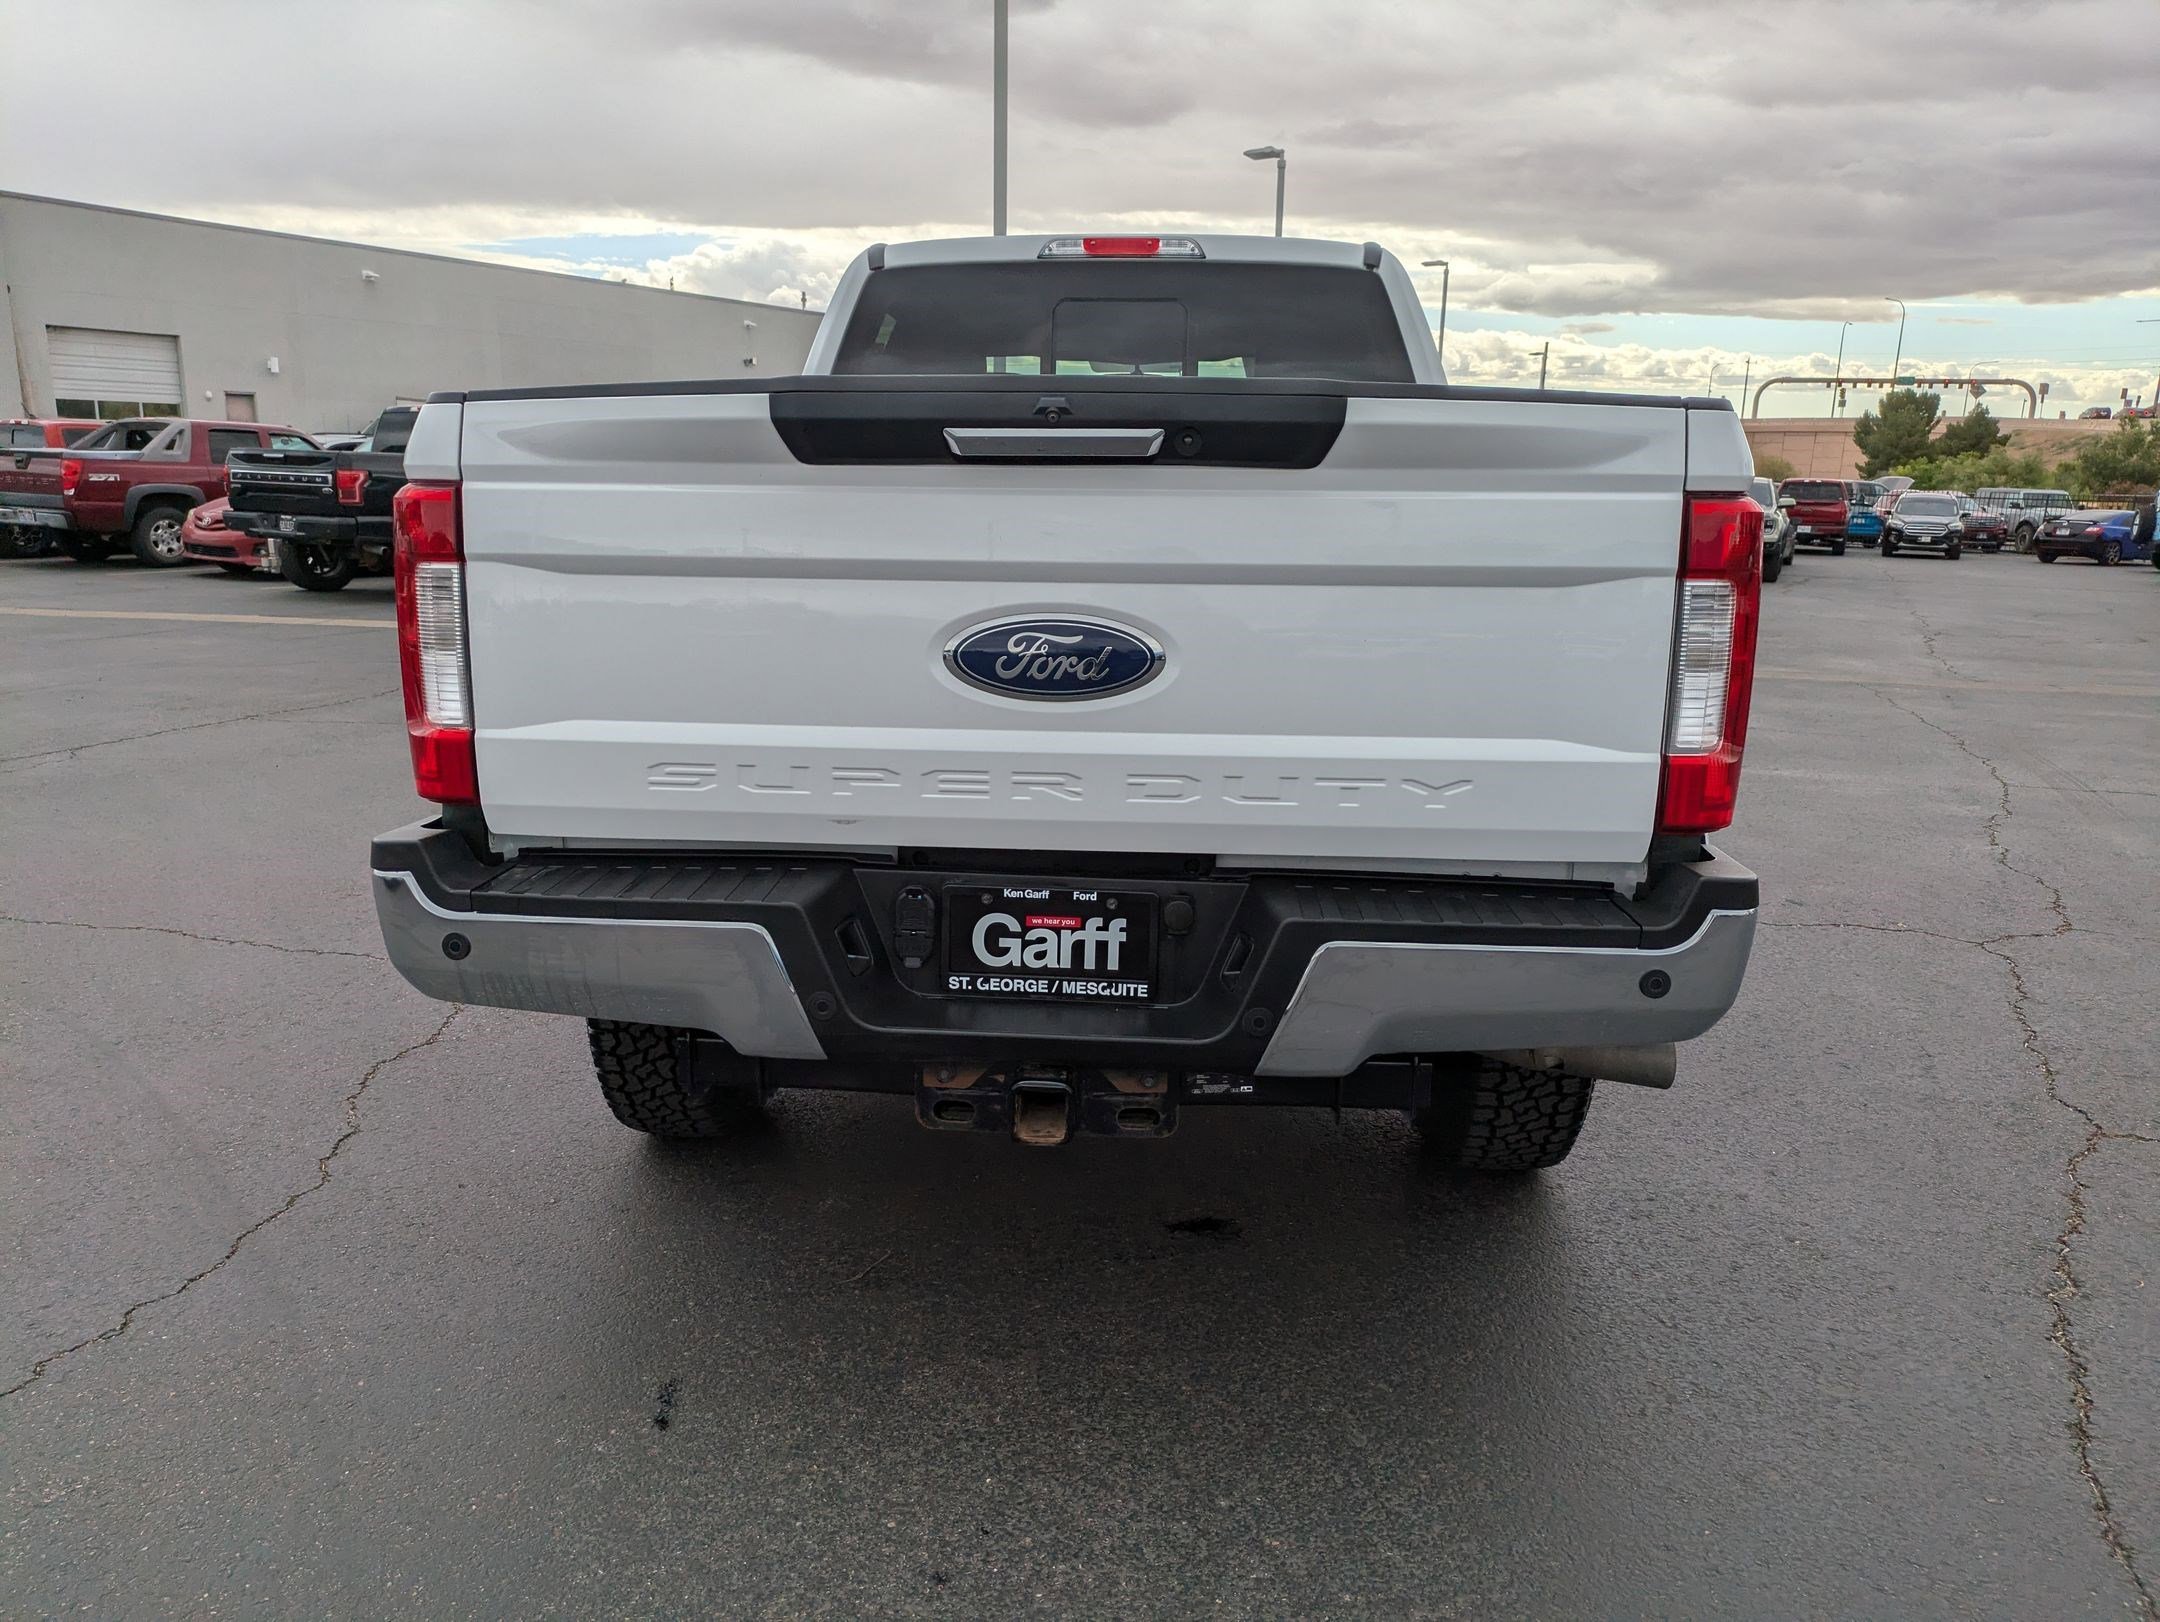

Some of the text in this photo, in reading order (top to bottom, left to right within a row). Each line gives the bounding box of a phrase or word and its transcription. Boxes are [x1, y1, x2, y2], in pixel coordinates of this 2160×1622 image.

[236, 473, 322, 482] PLATINUM
[995, 631, 1112, 681] Ford
[647, 762, 1473, 808] SUPER DUTY
[1003, 888, 1097, 901] Ken Garff Ford
[1043, 917, 1060, 925] hear
[1061, 918, 1075, 926] you
[971, 912, 1127, 971] Garff
[948, 976, 972, 990] ST.
[976, 977, 1049, 993] GEORGE
[1062, 981, 1149, 998] MESQUITE
